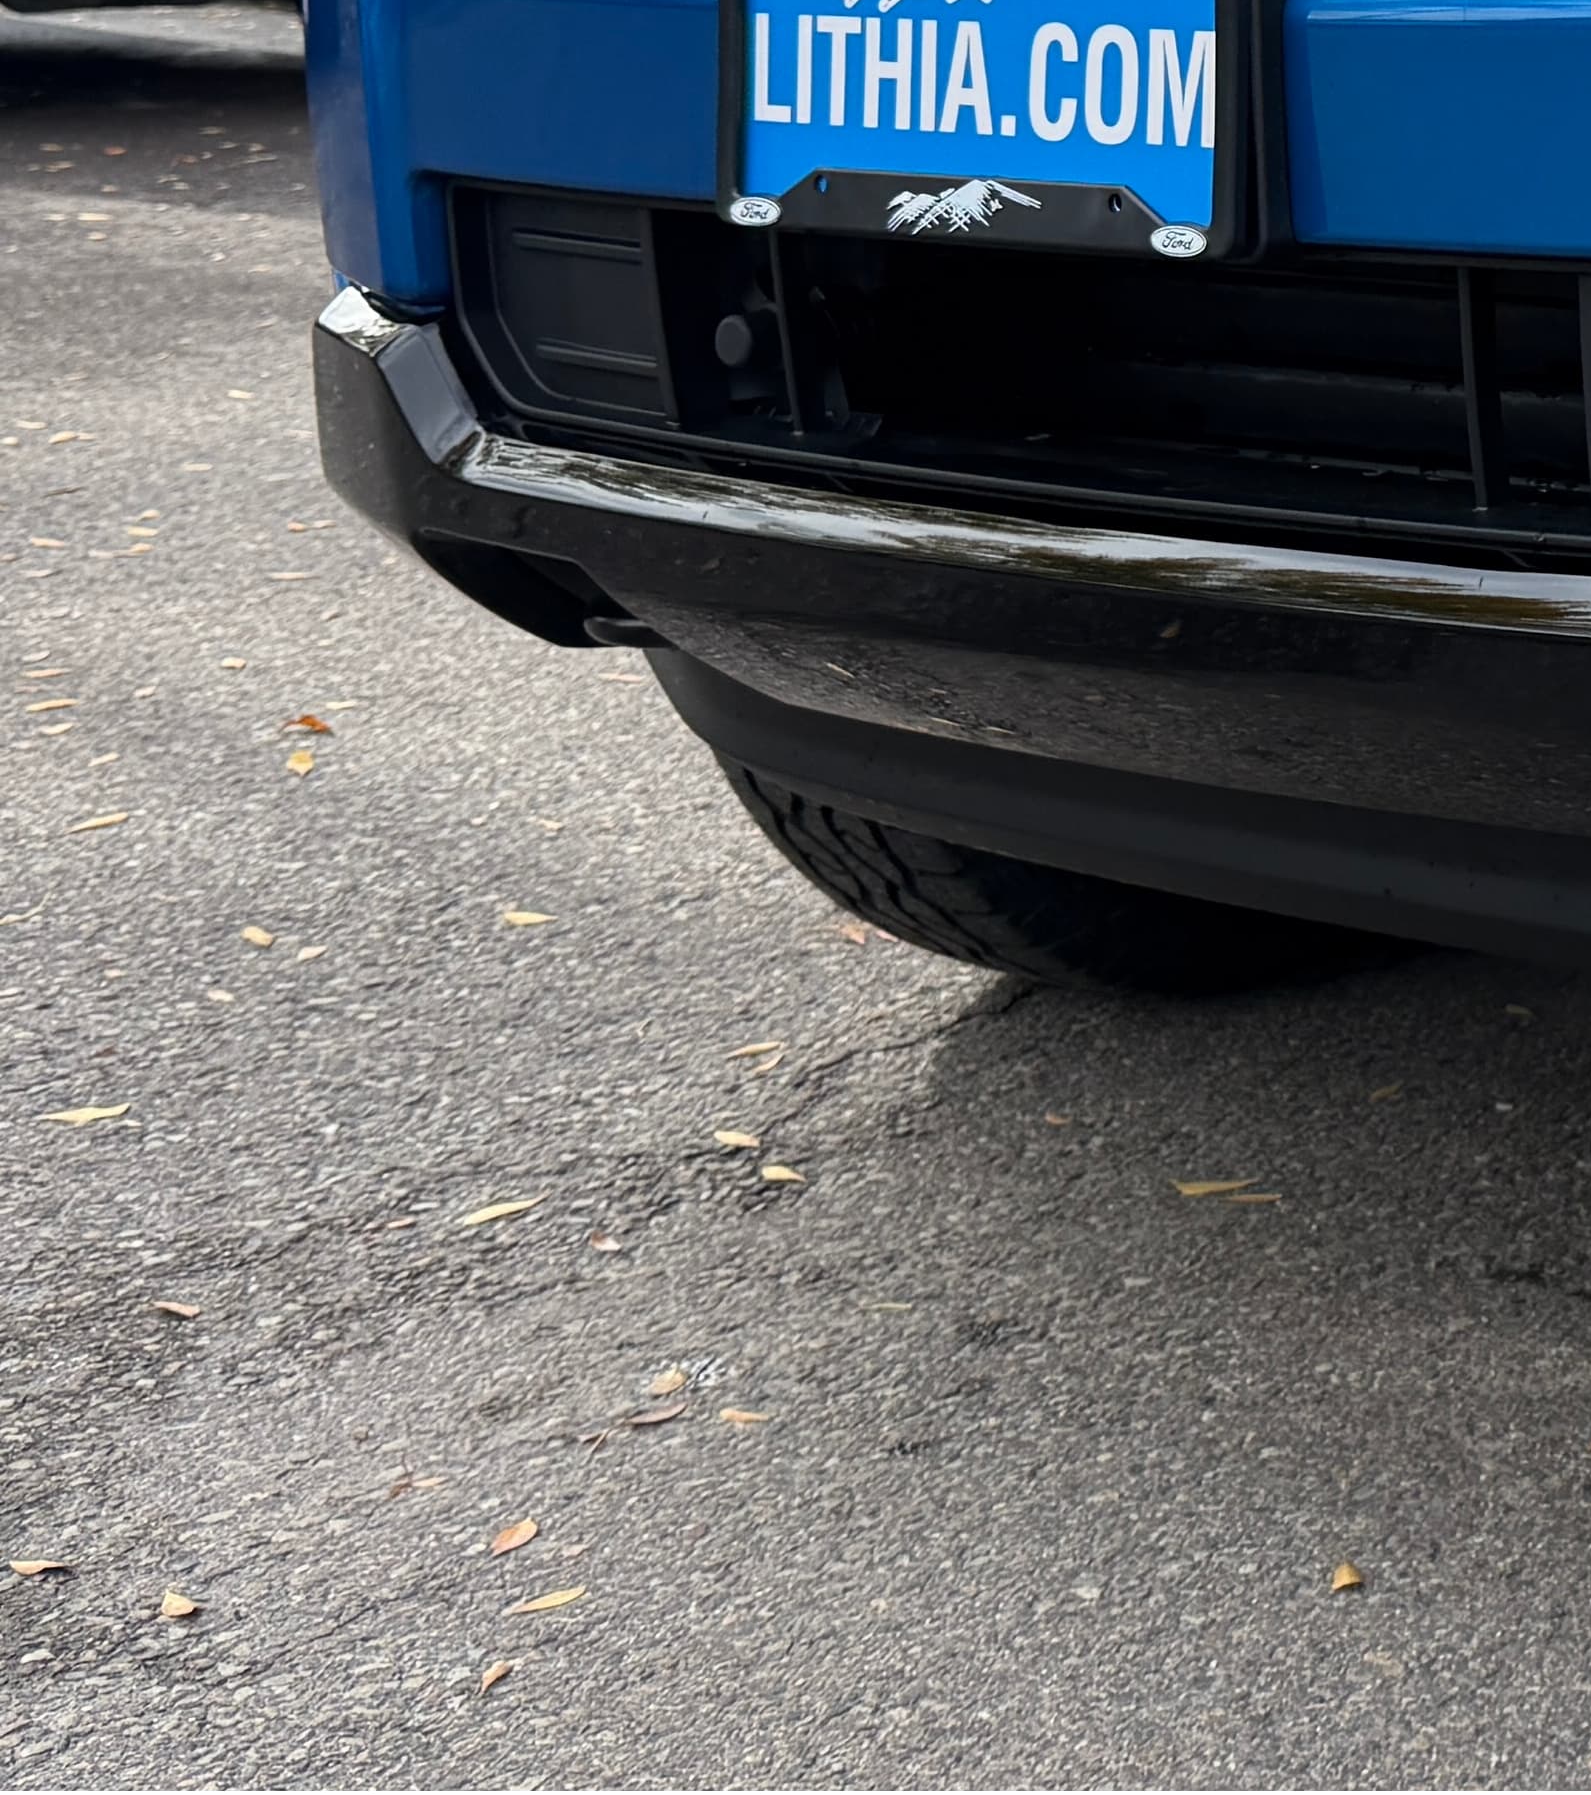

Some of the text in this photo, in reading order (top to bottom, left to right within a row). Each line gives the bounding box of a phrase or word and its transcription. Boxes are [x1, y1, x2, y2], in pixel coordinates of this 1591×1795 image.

[753, 12, 1217, 149] LITHIA.COM
[740, 202, 770, 219] Ford
[1162, 231, 1194, 250] Ford
